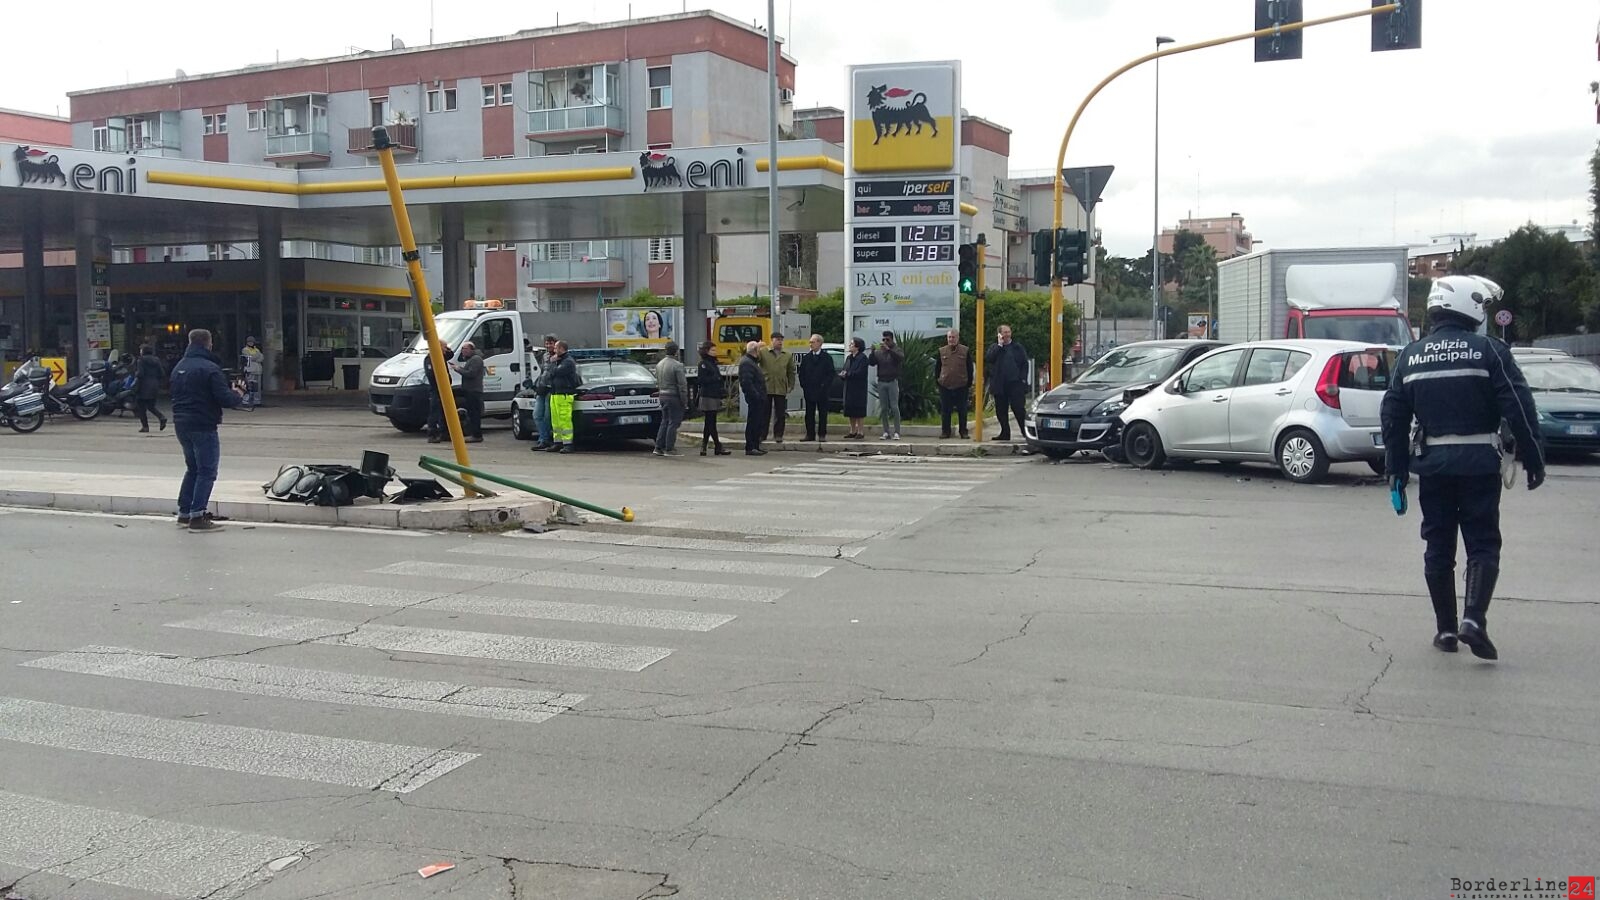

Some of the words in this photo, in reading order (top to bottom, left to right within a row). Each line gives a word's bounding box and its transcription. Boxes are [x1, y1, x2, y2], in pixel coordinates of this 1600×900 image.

[686, 147, 744, 188] eni
[71, 157, 137, 194] eni
[857, 184, 871, 195] qui
[902, 181, 951, 196] iperself
[856, 204, 871, 214] bar
[913, 203, 933, 213] shop
[856, 231, 880, 240] diesel
[856, 249, 879, 259] super
[856, 272, 893, 286] BAR
[1424, 339, 1468, 352] Polizia
[1408, 348, 1482, 366] Municipale
[606, 399, 626, 407] POLIZIA
[629, 398, 658, 406] MUNICIPALE
